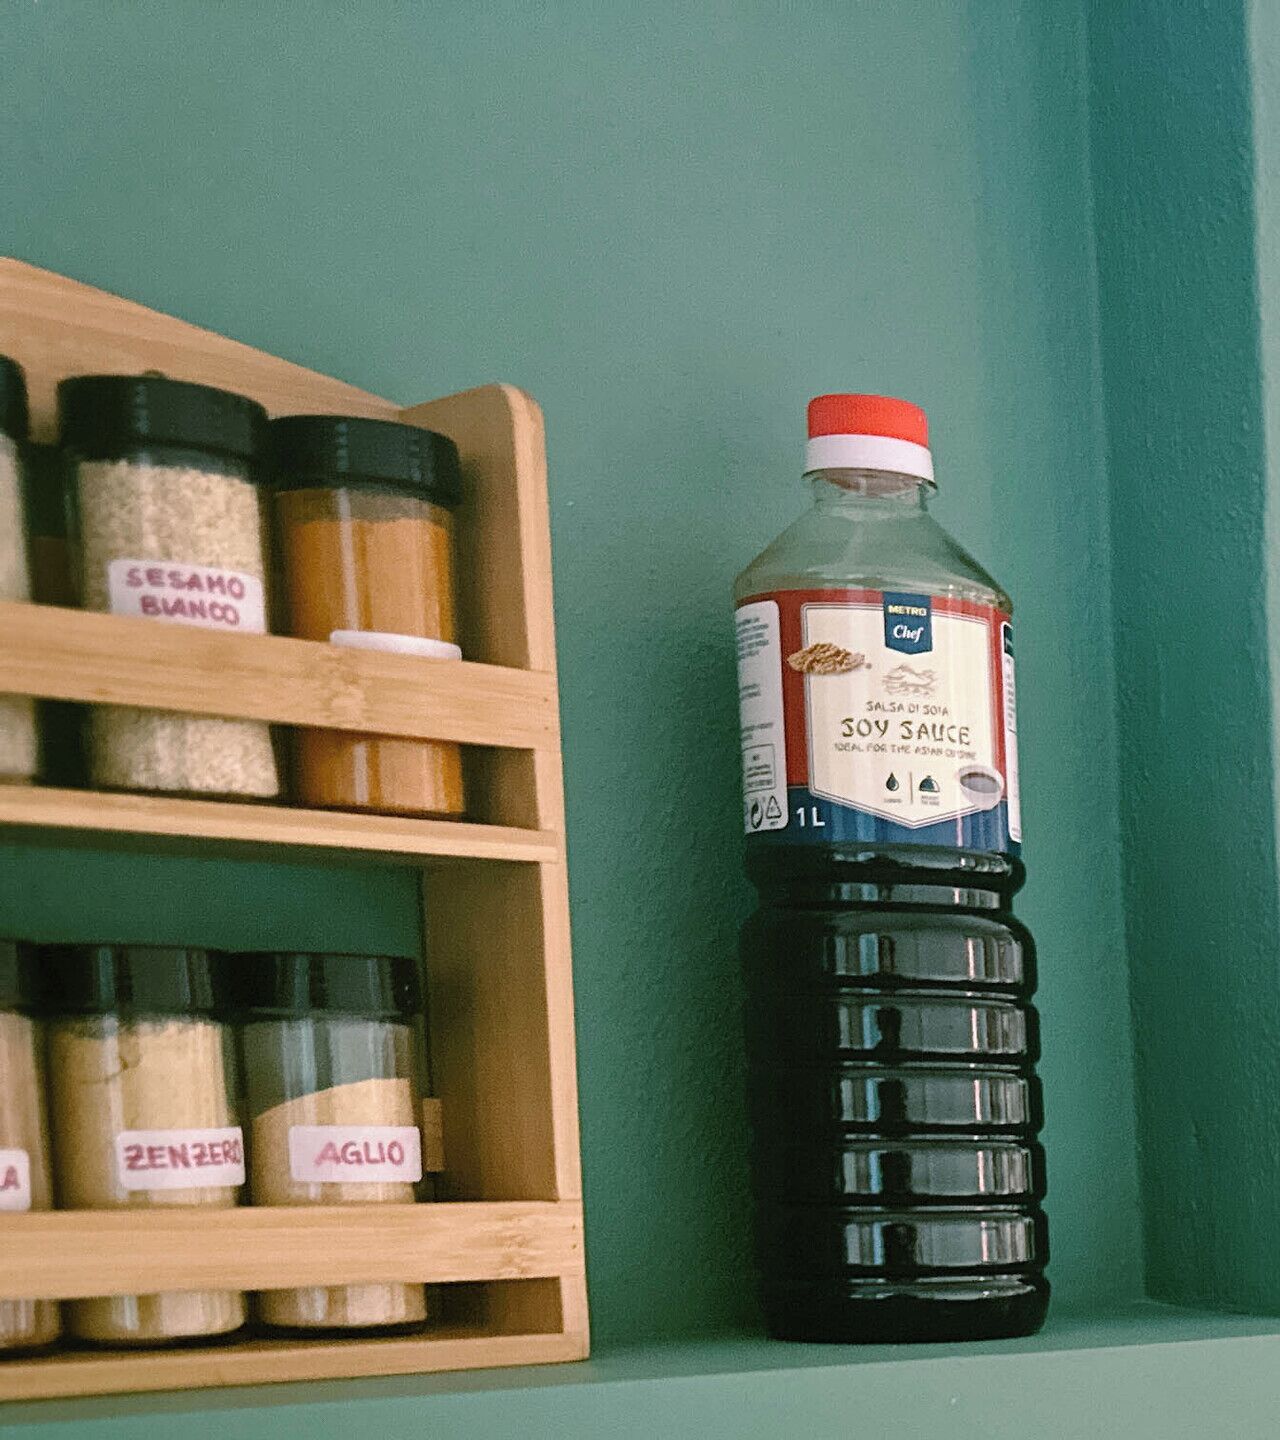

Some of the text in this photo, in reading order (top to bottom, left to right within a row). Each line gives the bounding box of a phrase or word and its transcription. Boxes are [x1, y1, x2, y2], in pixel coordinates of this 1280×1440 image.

[126, 568, 245, 600] SESAMO
[140, 595, 240, 626] BIANCO
[888, 605, 927, 617] METRO
[893, 624, 924, 643] Chef
[866, 701, 949, 716] SALSA DI SOIA
[841, 717, 970, 746] SOY SAUCE
[314, 1140, 405, 1167] AGLIO
